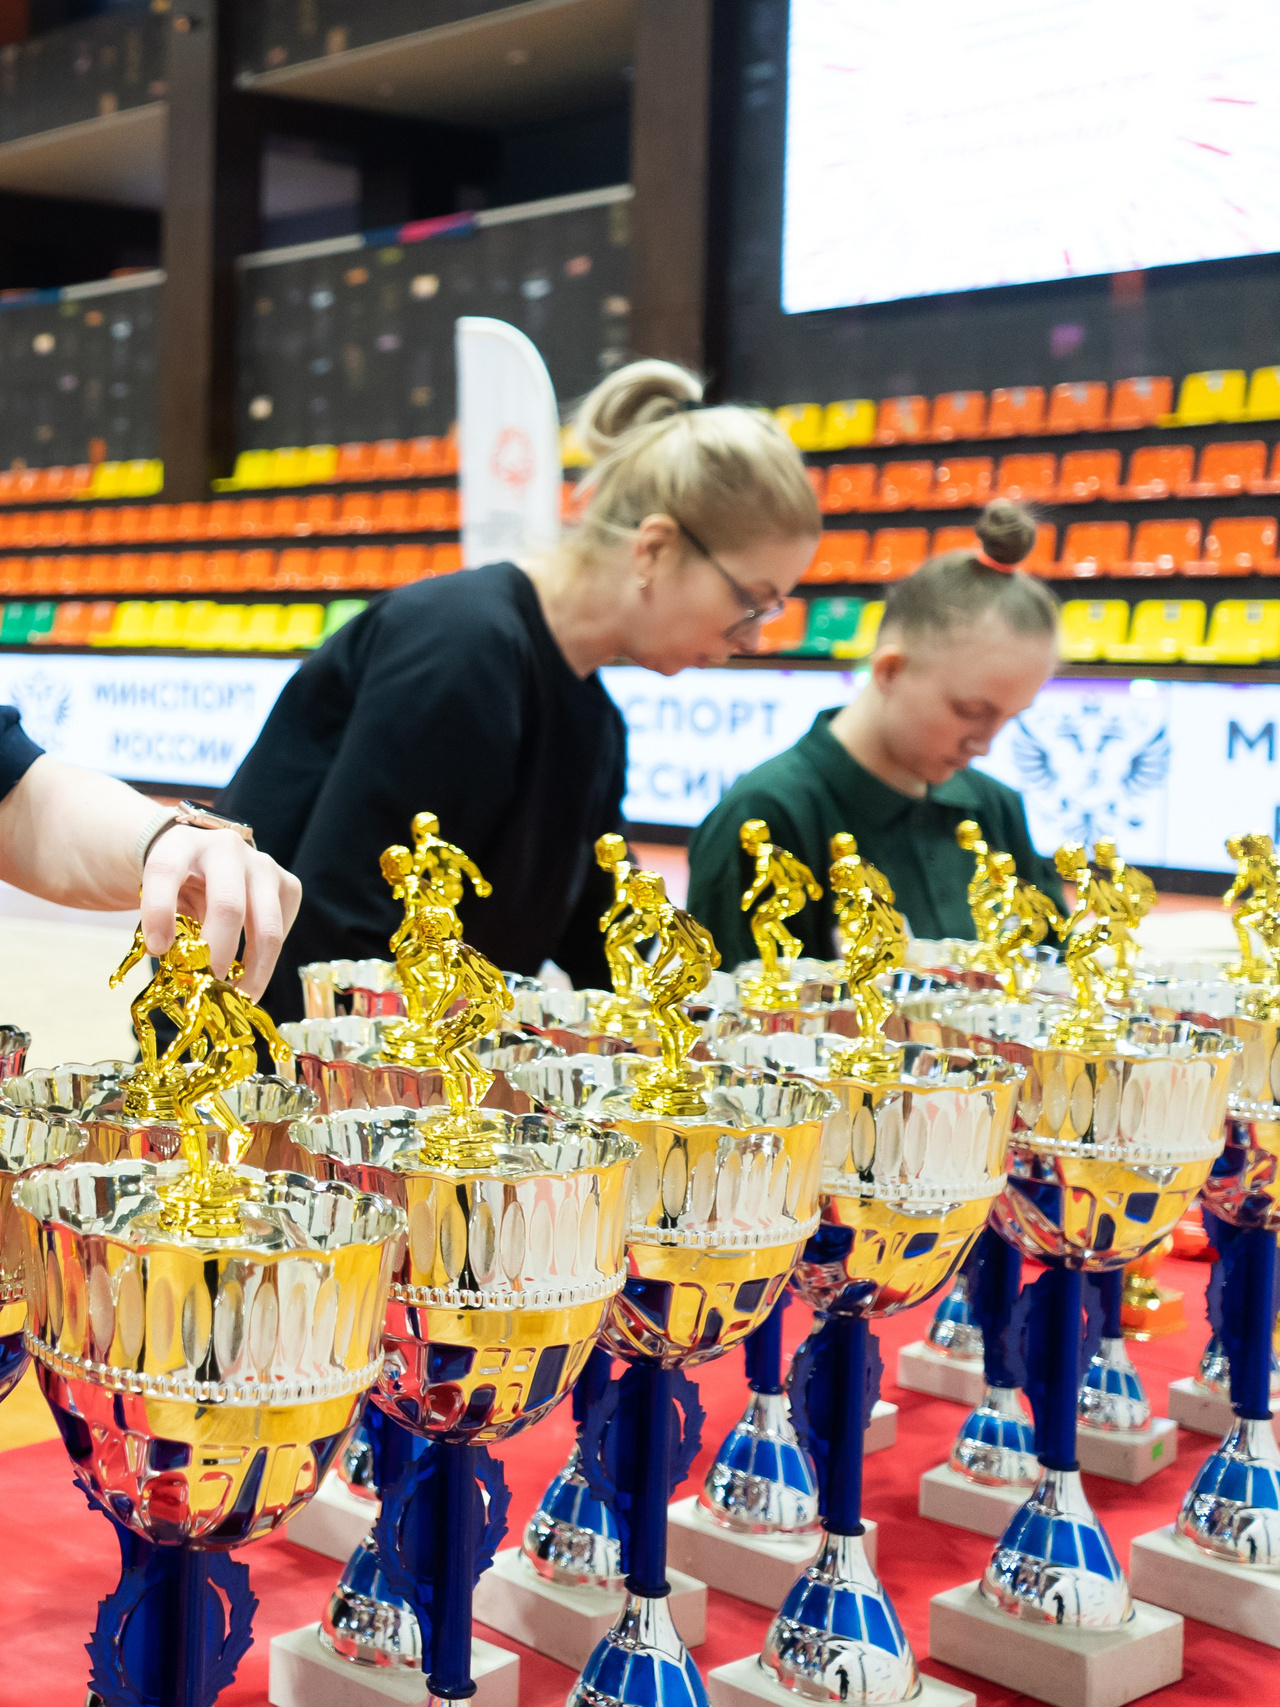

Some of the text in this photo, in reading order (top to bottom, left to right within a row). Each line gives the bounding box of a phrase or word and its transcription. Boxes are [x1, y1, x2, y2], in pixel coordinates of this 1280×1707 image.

[92, 680, 258, 713] МИНСПОРТ
[625, 695, 781, 738] СПОРТ
[112, 730, 236, 766] РОССИИ
